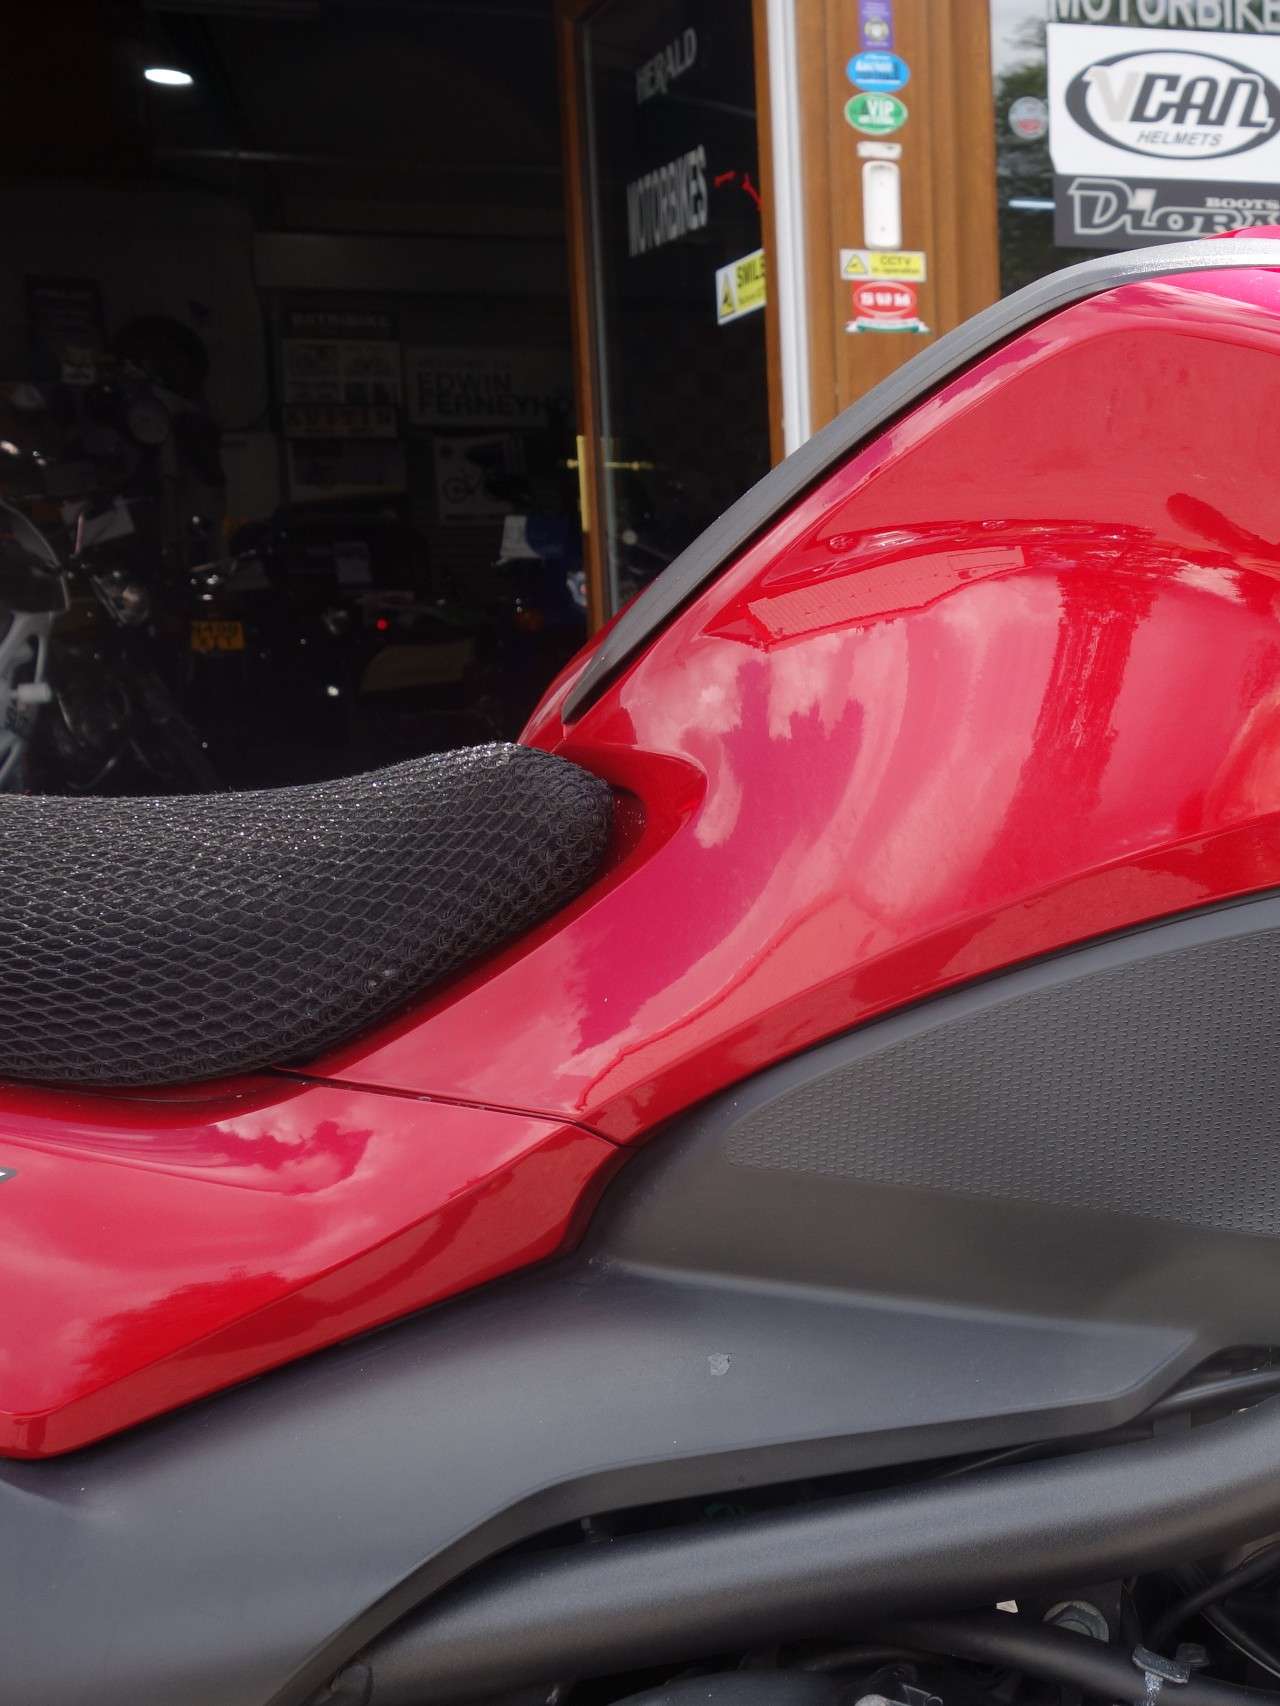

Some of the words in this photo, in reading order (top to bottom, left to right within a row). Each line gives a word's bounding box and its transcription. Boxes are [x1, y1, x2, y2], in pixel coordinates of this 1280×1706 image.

[1137, 130, 1222, 147] HELMETS
[1205, 196, 1280, 210] BOOTS
[879, 255, 912, 266] CCTV
[416, 371, 513, 392] EDWIN
